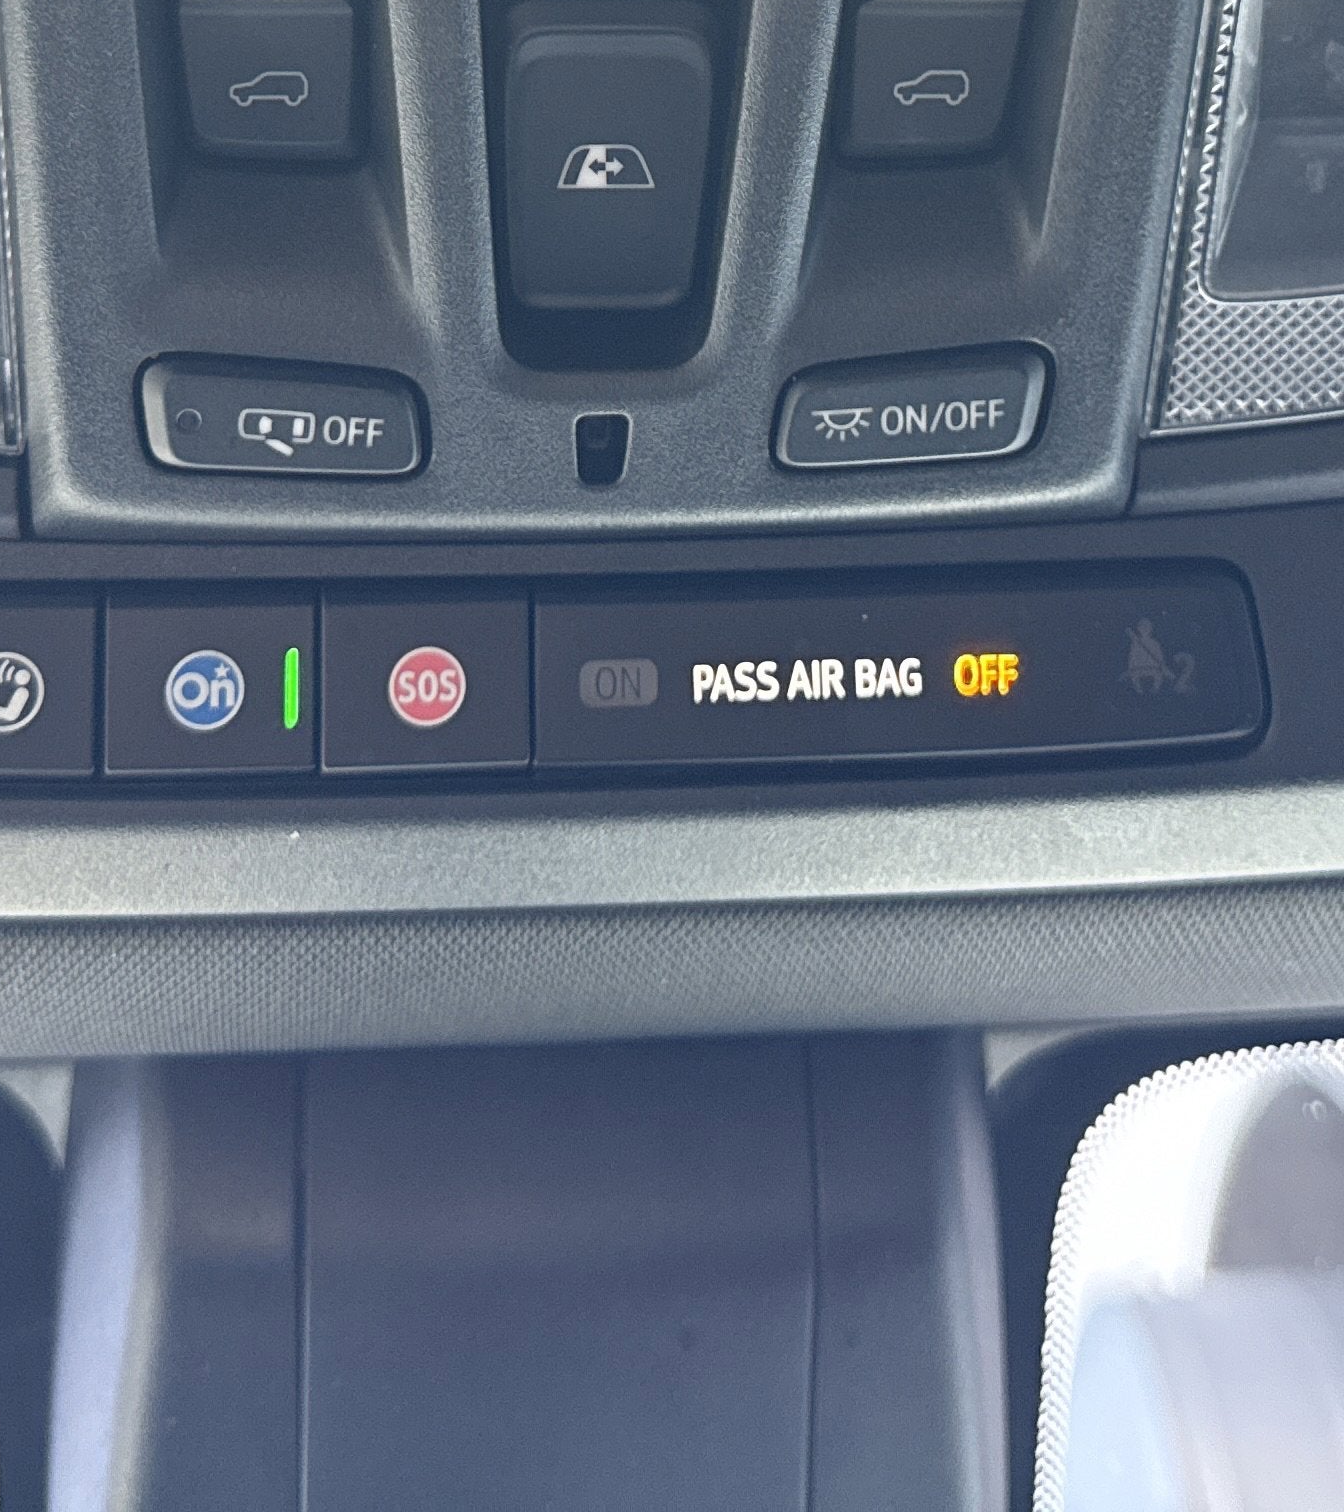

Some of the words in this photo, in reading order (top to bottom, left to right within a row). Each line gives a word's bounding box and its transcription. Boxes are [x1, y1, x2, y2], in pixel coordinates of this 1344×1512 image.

[321, 415, 385, 449] OFF
[879, 398, 1005, 436] ON/OFF
[172, 669, 236, 709] On
[396, 667, 458, 703] SOS
[594, 665, 642, 700] ON
[692, 659, 780, 704] PASS
[786, 659, 846, 701] AIR
[854, 657, 923, 698] BAG
[953, 652, 1020, 697] OFF
